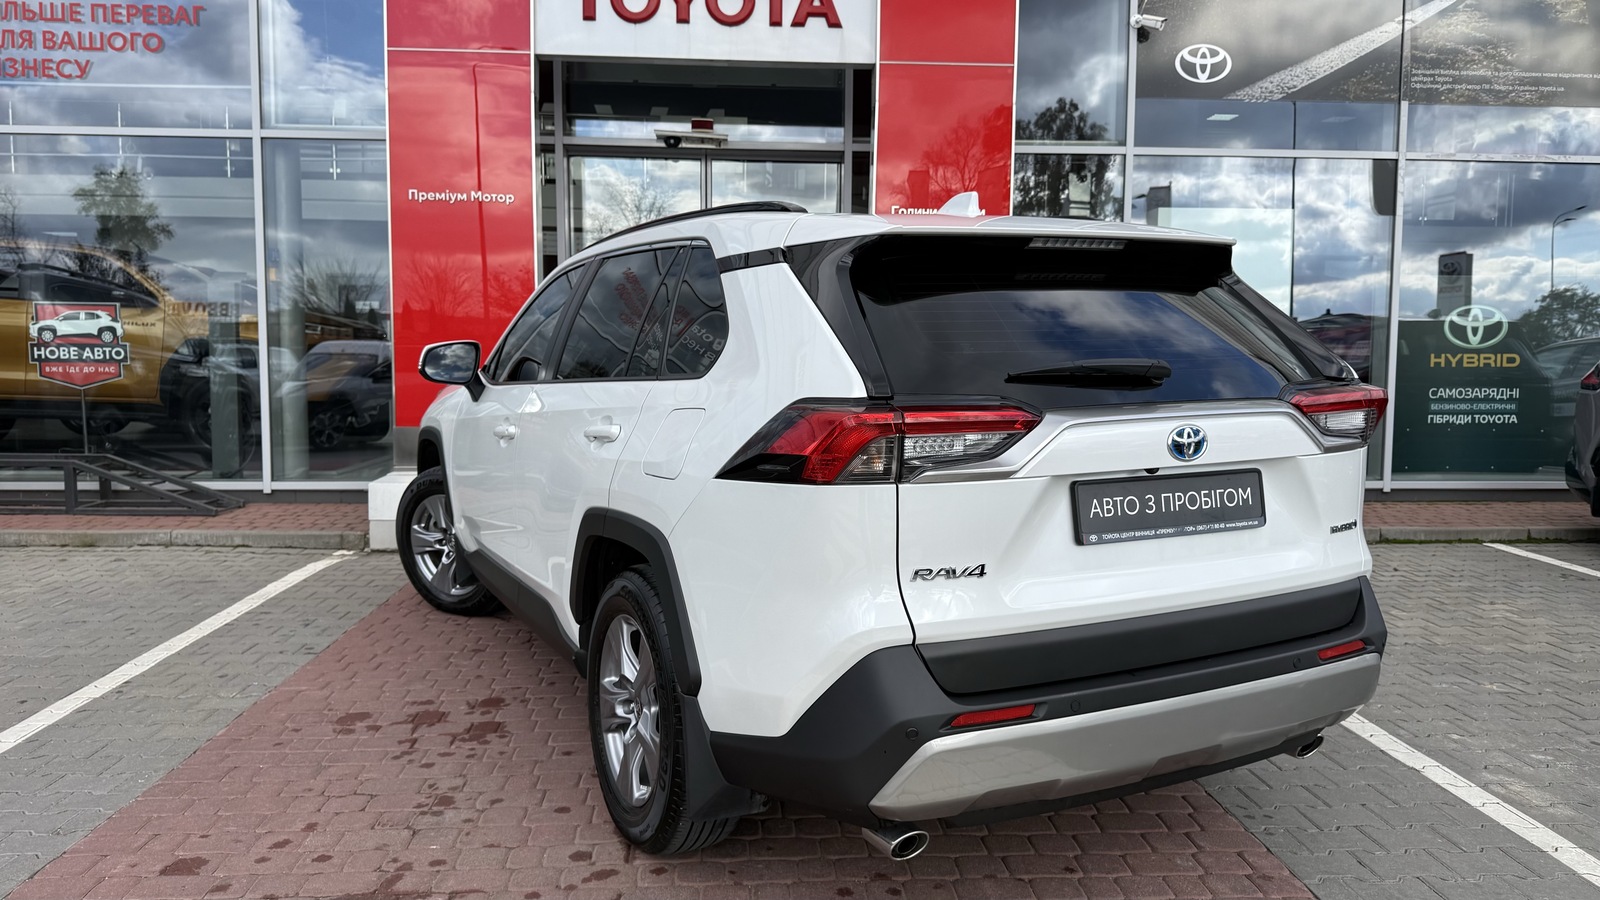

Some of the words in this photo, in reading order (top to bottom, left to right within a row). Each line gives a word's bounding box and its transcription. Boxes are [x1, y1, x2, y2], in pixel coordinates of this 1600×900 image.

[0, 1, 83, 22] ЛЬШЕ
[91, 3, 205, 25] ПЕРЕВАГ
[0, 28, 34, 49] ЛЯ
[42, 30, 164, 53] ВАШОГО
[0, 56, 91, 79] ЗНЕСУ
[1539, 86, 1565, 94] toyota.ua
[408, 189, 467, 204] Преміум
[470, 190, 515, 205] Мотор
[33, 346, 79, 360] НОВЕ
[82, 346, 125, 360] АВТО
[1430, 353, 1520, 367] HYBRID
[1429, 387, 1520, 400] САМОЗАРЯДНІ
[1427, 414, 1472, 425] ГІБРИДИ
[1473, 414, 1518, 424] TOYOTA
[1090, 495, 1140, 518] АВТО
[1145, 494, 1156, 514] З
[1161, 486, 1252, 513] ПРОБІГОМ
[910, 562, 987, 583] RAV4
